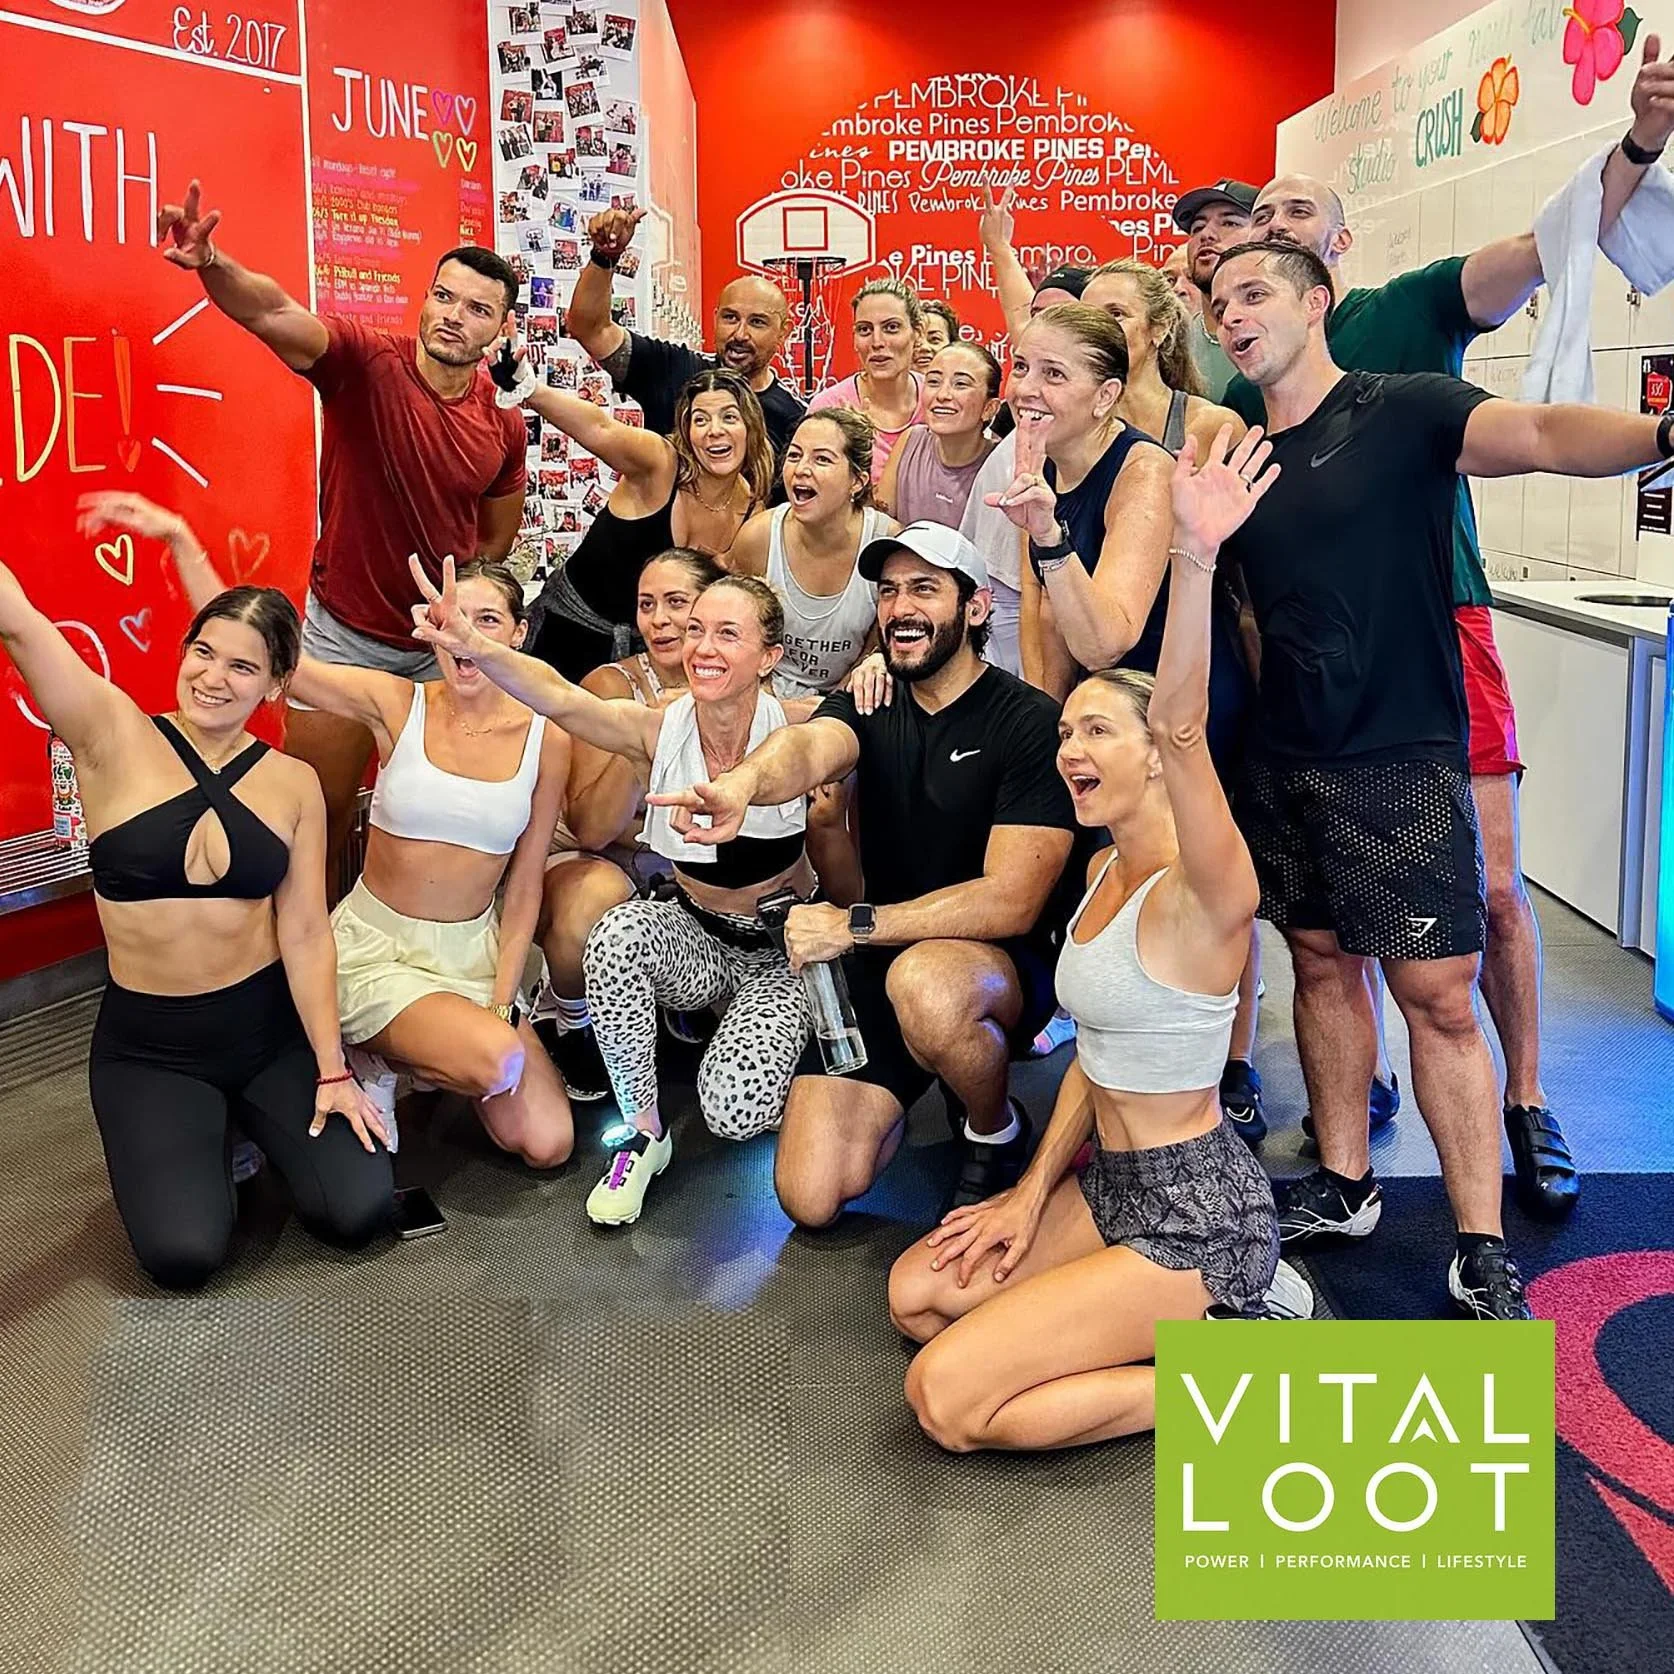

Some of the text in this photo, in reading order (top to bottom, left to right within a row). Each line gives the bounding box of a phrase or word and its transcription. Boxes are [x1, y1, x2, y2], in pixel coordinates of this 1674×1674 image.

[172, 6, 287, 69] Est. 2017
[332, 67, 429, 142] JUNE
[1313, 90, 1382, 143] Welcome
[822, 112, 922, 137] mbroke
[929, 112, 990, 135] Pines
[1415, 88, 1464, 168] CRUSH
[888, 140, 1025, 162] PEMBROKE
[1034, 138, 1105, 161] PINES
[781, 159, 834, 189] oke
[841, 158, 912, 188] Pines
[1032, 157, 1100, 191] Pines
[1060, 187, 1178, 211] Pembroke
[911, 244, 976, 266] Pines
[789, 649, 819, 666] FOR
